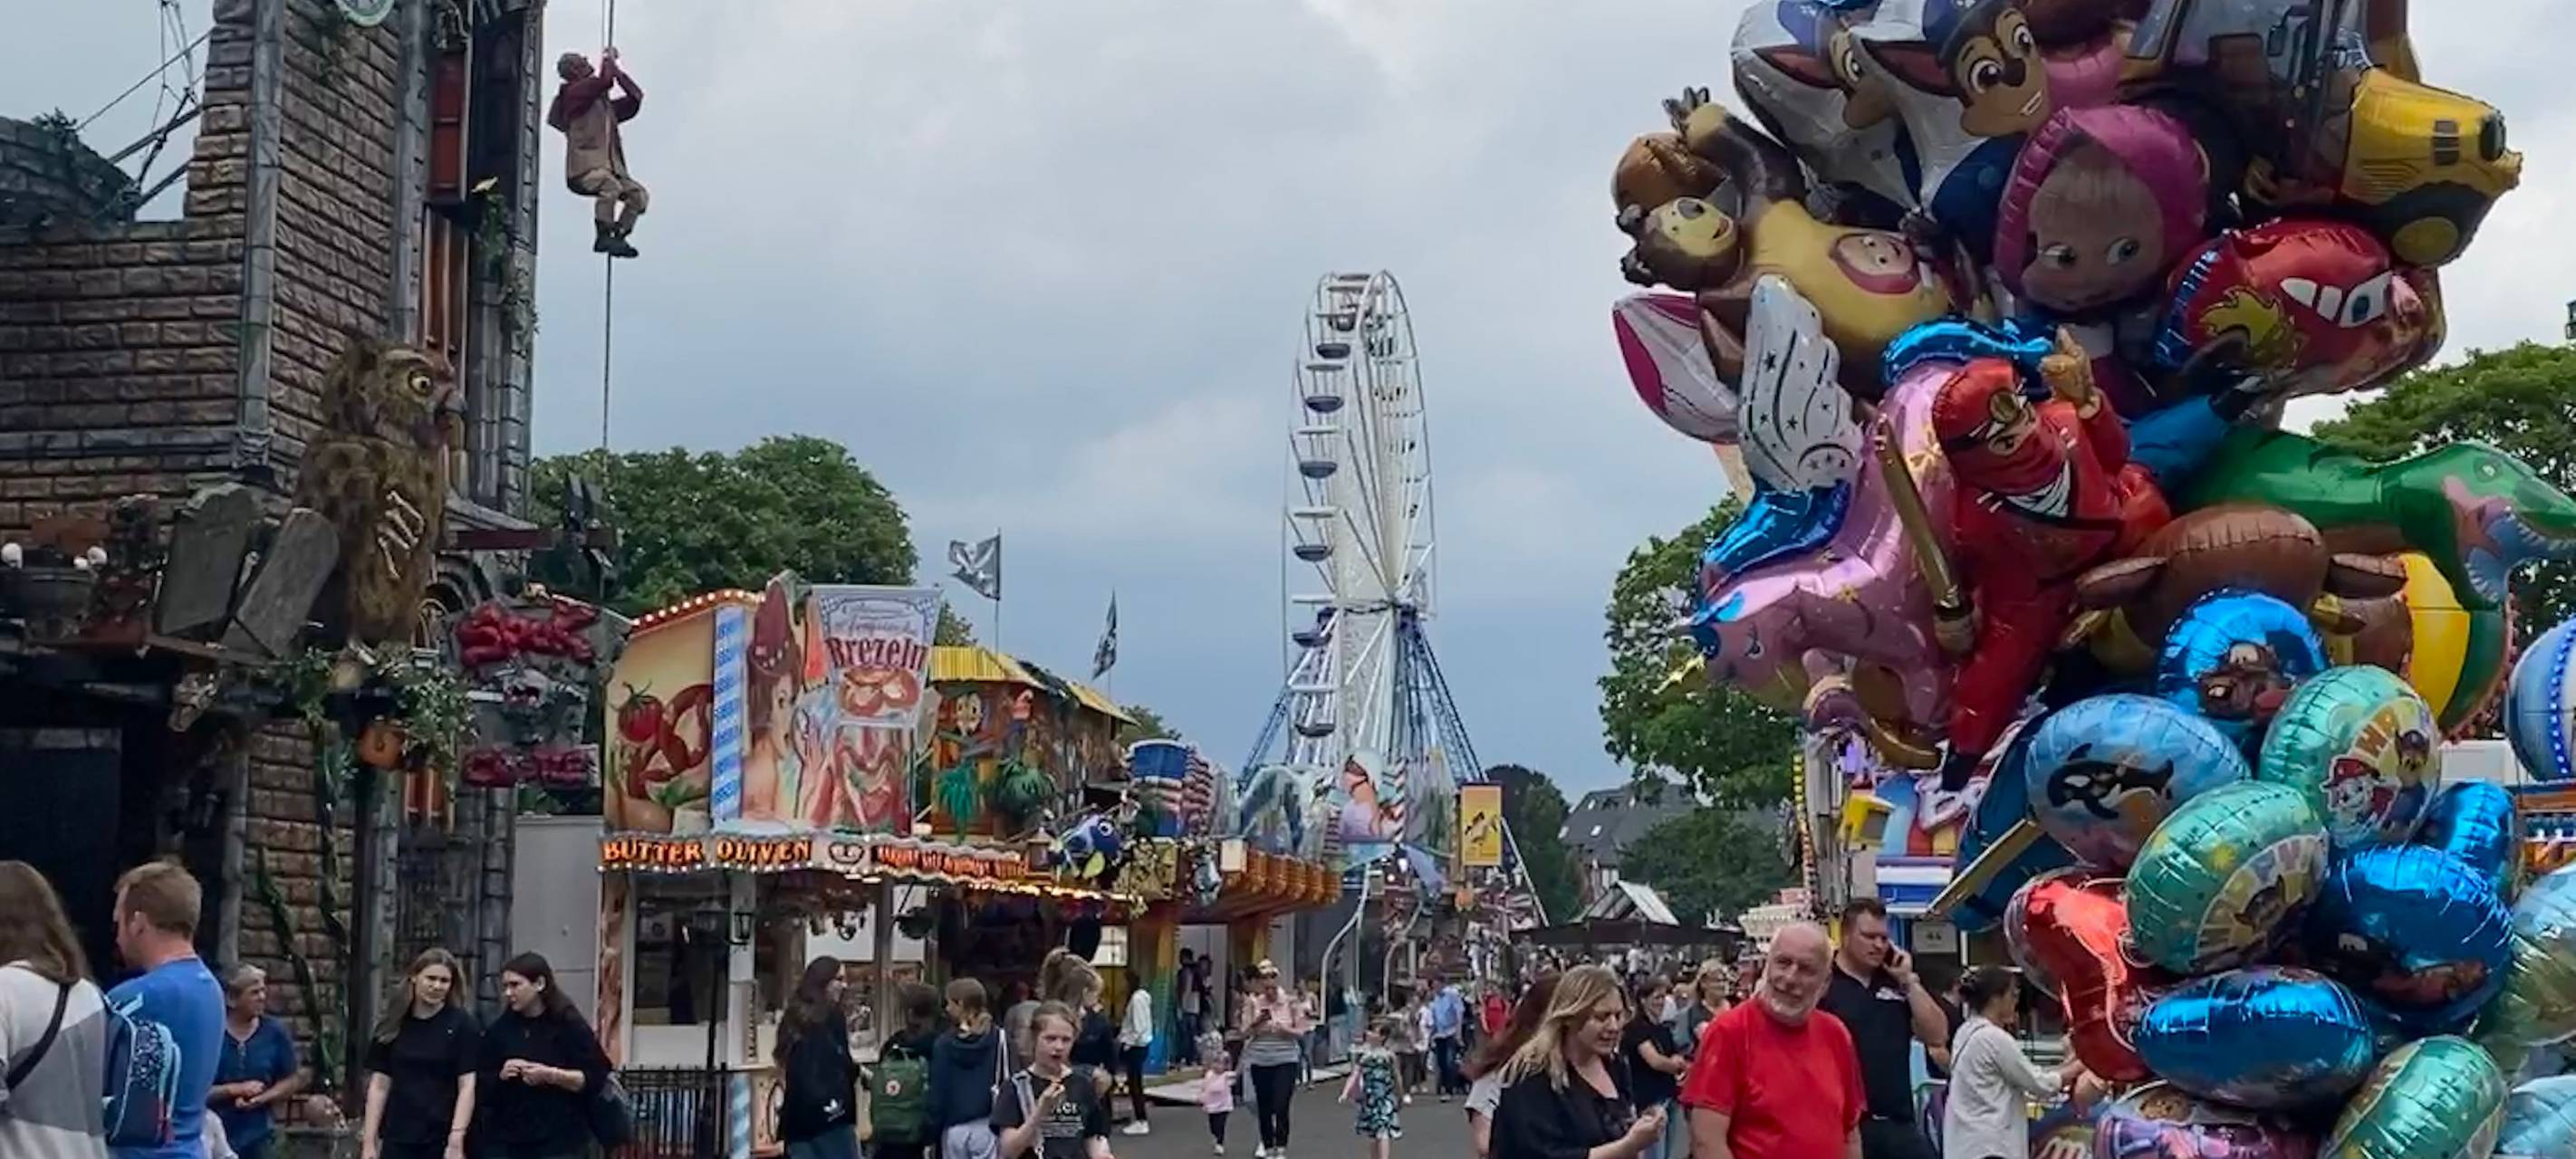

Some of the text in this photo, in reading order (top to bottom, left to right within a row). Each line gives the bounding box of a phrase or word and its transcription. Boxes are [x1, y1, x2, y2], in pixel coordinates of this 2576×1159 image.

[824, 636, 928, 671] Brezeln
[602, 838, 813, 863] BUTTER OLIVEN
